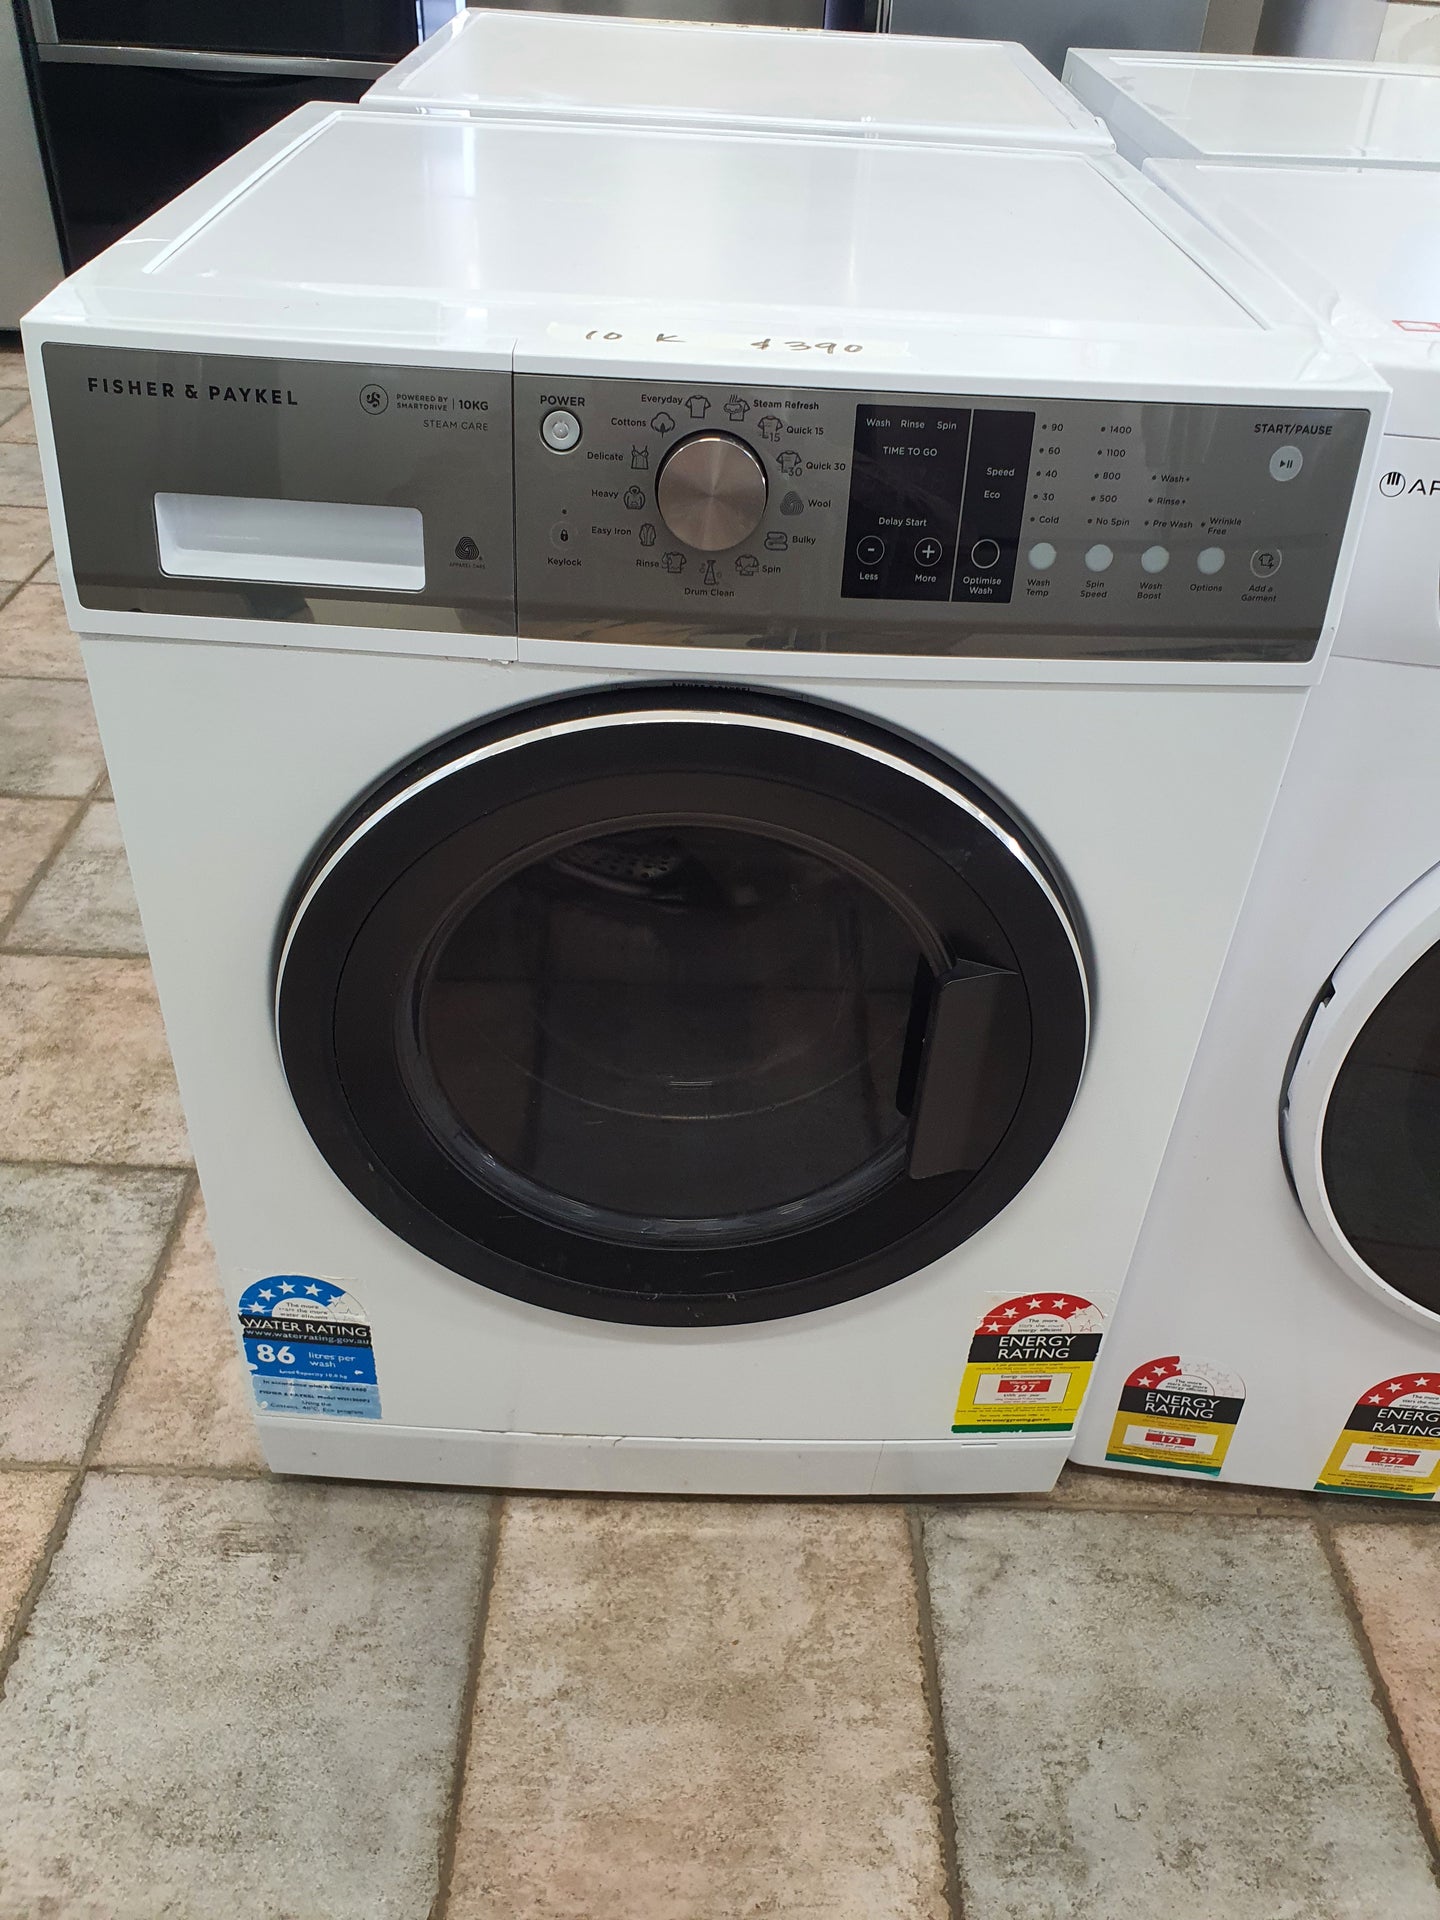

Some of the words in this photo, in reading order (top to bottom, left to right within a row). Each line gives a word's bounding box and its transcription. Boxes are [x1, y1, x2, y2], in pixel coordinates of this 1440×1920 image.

[87, 377, 174, 398] FISHER
[185, 384, 198, 399] &
[209, 385, 298, 405] PAYKEL
[396, 393, 436, 402] POWERED
[540, 395, 585, 407] POWER
[641, 394, 683, 405] Everyday
[458, 399, 489, 411] 10KG
[753, 399, 782, 409] Steam
[784, 401, 819, 410] Refresh
[423, 419, 458, 429] STEAM
[460, 421, 488, 431] CARE
[611, 417, 647, 427] Cottons
[866, 418, 891, 428] Wash
[901, 420, 925, 430] Rinse
[937, 421, 957, 431] Spin
[786, 426, 812, 435] Quick
[815, 427, 824, 435] 15
[1051, 423, 1064, 432] 90
[1109, 425, 1132, 434] 1400
[1254, 423, 1333, 435] START/PAUSE
[883, 446, 905, 455] TIME
[908, 447, 921, 456] TO
[923, 447, 938, 457] GO
[1048, 446, 1061, 456] 60
[1106, 449, 1126, 458] 1100
[587, 451, 624, 462] Delicate
[805, 461, 831, 471] Quick
[834, 463, 846, 471] 30
[986, 466, 1015, 477] Speed
[1045, 469, 1058, 479] 40
[1102, 472, 1121, 481] 800
[591, 489, 619, 500] Heavy
[984, 490, 1000, 499] Eco
[1042, 492, 1055, 502] 30
[1099, 494, 1118, 503] 500
[808, 499, 831, 509] Wool
[878, 517, 904, 527] Delay
[905, 518, 927, 527] Start
[1039, 515, 1060, 525] Cold
[1096, 517, 1110, 527] No
[1112, 518, 1130, 528] Spin
[1152, 519, 1168, 528] Pre
[1170, 520, 1193, 529] Wash
[1210, 517, 1242, 526] Wrinkle
[591, 526, 611, 537] Easy
[614, 527, 632, 537] Iron
[1207, 527, 1227, 535] Free
[792, 535, 817, 546] Bulky
[547, 557, 582, 567] Keylock
[636, 559, 660, 568] Rinse
[762, 564, 781, 575] Spin
[859, 572, 878, 581] Less
[914, 574, 937, 583] More
[963, 576, 1002, 587] Optimise
[1027, 579, 1051, 587] Wash
[1085, 580, 1105, 589] Spin
[1139, 582, 1163, 590] Wash
[1248, 584, 1266, 592] Add
[684, 588, 707, 597] Drum
[710, 588, 735, 598] Clean
[969, 585, 993, 595] Wash
[1026, 588, 1049, 598] Temp
[1189, 584, 1223, 593] Options
[1080, 590, 1108, 599] Speed
[1137, 591, 1162, 600] Boost
[1241, 593, 1277, 603] Garment
[243, 1318, 302, 1333] WATER
[305, 1323, 367, 1337] RATING
[245, 1329, 369, 1345] www.waterrating.gov.au
[998, 1336, 1076, 1347] ENERGY
[256, 1343, 296, 1365] 86
[308, 1352, 335, 1360] litres
[338, 1355, 356, 1364] per
[997, 1348, 1070, 1359] RATING
[1012, 1384, 1036, 1392] 297
[1145, 1392, 1220, 1409] ENERGY
[1144, 1402, 1214, 1419] RATING
[1372, 1422, 1440, 1437] RATING
[1161, 1435, 1182, 1444] 173
[1380, 1455, 1404, 1465] 277
